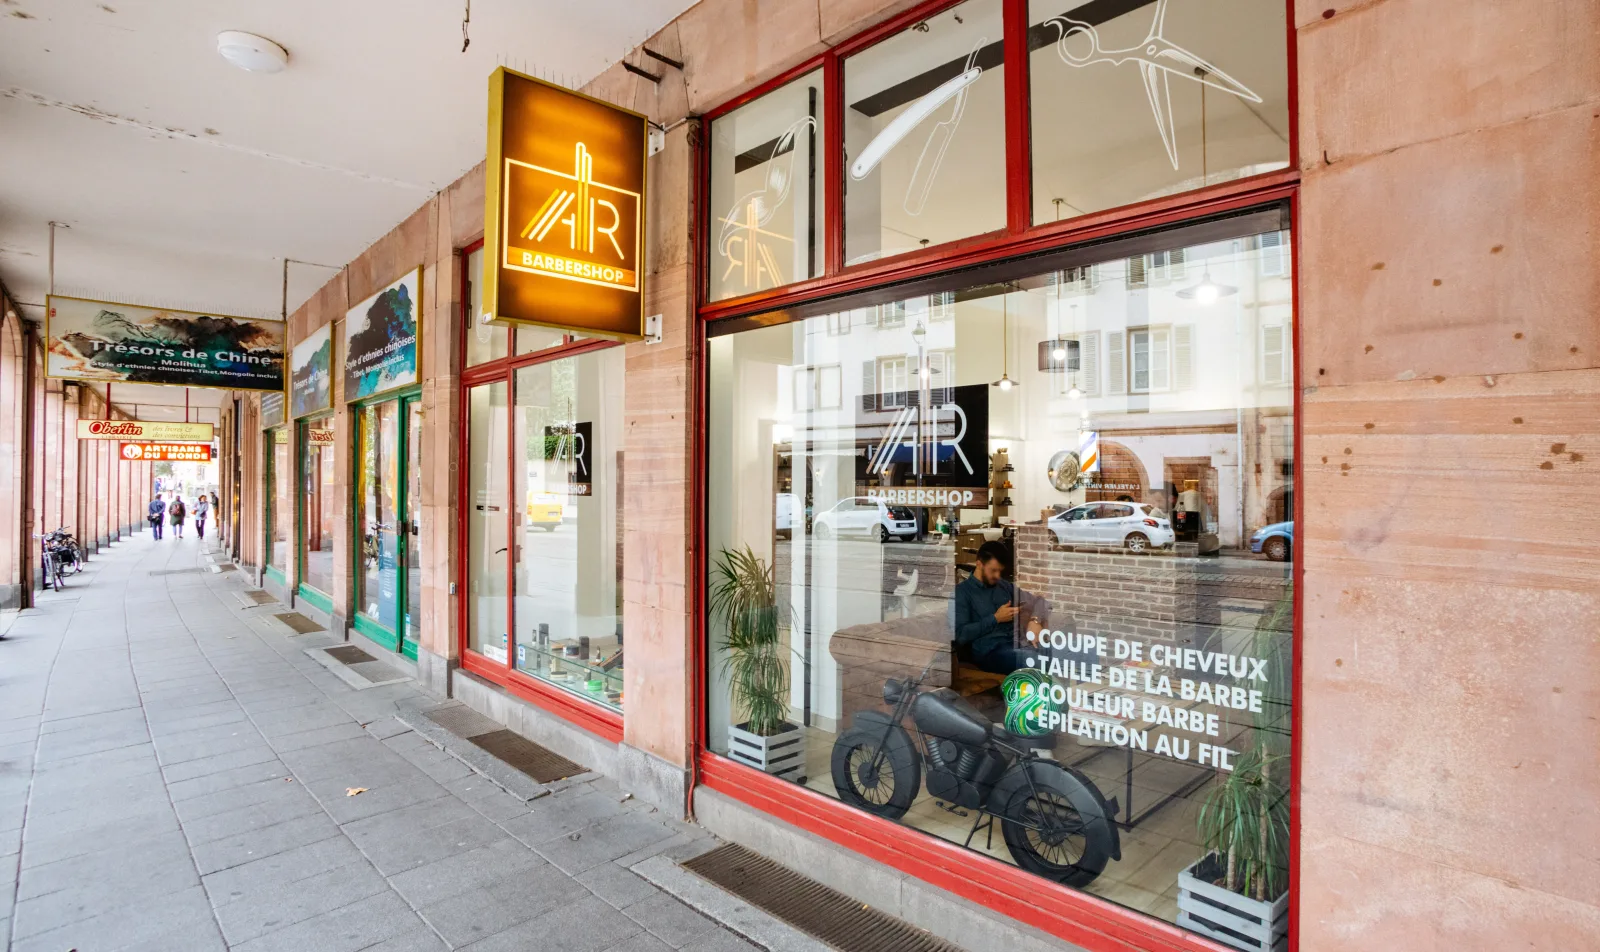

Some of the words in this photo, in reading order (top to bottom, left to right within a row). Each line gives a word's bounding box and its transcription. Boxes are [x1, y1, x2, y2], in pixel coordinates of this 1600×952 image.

[522, 252, 624, 283] BARBERSHOP
[89, 339, 175, 358] Trésors
[182, 348, 208, 360] de
[215, 351, 271, 366] Chine
[91, 361, 115, 369] Style
[116, 363, 156, 371] d'ethnies
[161, 359, 206, 369] Molihua
[89, 421, 143, 435] Oberlin
[865, 403, 975, 476] AR
[144, 445, 202, 453] ARTISANS
[167, 452, 209, 460] MONDE
[867, 489, 974, 507] BARBERSHOP
[1037, 629, 1108, 657] COUPE
[1114, 639, 1143, 662] DE
[1150, 644, 1268, 682] CHEVEUX
[1037, 654, 1102, 685] TAILLE
[1109, 667, 1138, 691] DE
[1145, 673, 1173, 698] LA
[1180, 675, 1263, 713] BARBE
[1038, 682, 1135, 719] COULEUR
[1142, 701, 1219, 737] BARBE
[1037, 702, 1148, 752] ÉPILATION
[1154, 734, 1190, 760] AU
[1198, 743, 1234, 772] FIL
